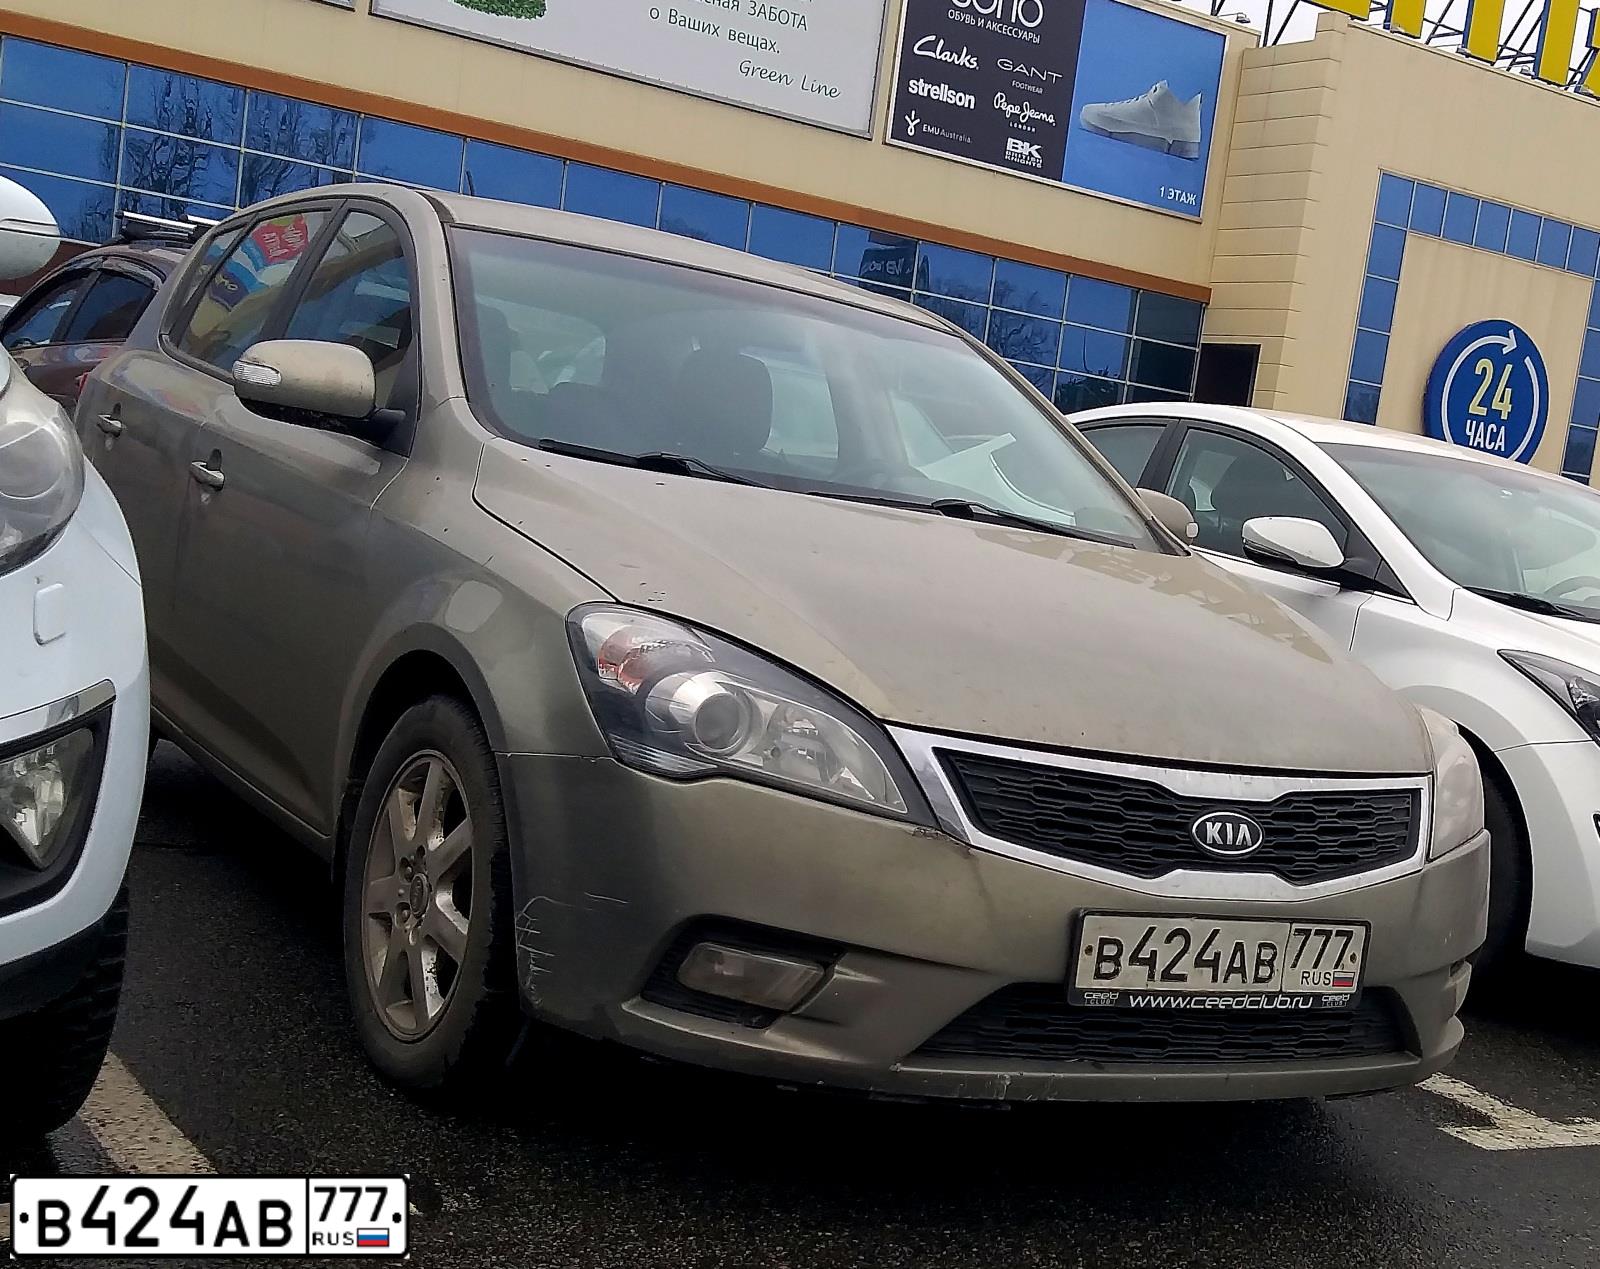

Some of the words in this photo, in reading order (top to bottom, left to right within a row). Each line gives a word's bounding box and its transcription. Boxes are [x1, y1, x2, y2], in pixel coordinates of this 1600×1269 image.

[649, 7, 660, 19] о
[668, 8, 721, 38] Ваших
[728, 28, 780, 54] вещах.
[747, 1, 808, 31] ЗАБОТА
[948, 9, 976, 25] ОБУВЬ
[977, 17, 985, 28] И
[985, 20, 1041, 44] АКСЕССУАРЫ
[913, 35, 978, 69] Clarks
[739, 60, 794, 86] Green
[801, 74, 841, 98] Line
[997, 58, 1063, 84] GANT
[908, 78, 976, 110] strellson
[1011, 80, 1044, 95] FOOTWEAR
[922, 123, 940, 136] EMU
[940, 130, 972, 144] Australia
[1006, 137, 1042, 159] BK
[1160, 186, 1165, 198] 1
[1167, 188, 1197, 206] ЭТАЖ
[1468, 358, 1513, 420] 24
[1465, 420, 1506, 452] ЧАСА
[1205, 821, 1252, 847] KIA
[1290, 928, 1354, 971] 777
[1301, 971, 1332, 986] RUS
[1129, 994, 1313, 1009] www.ceedclub.ru
